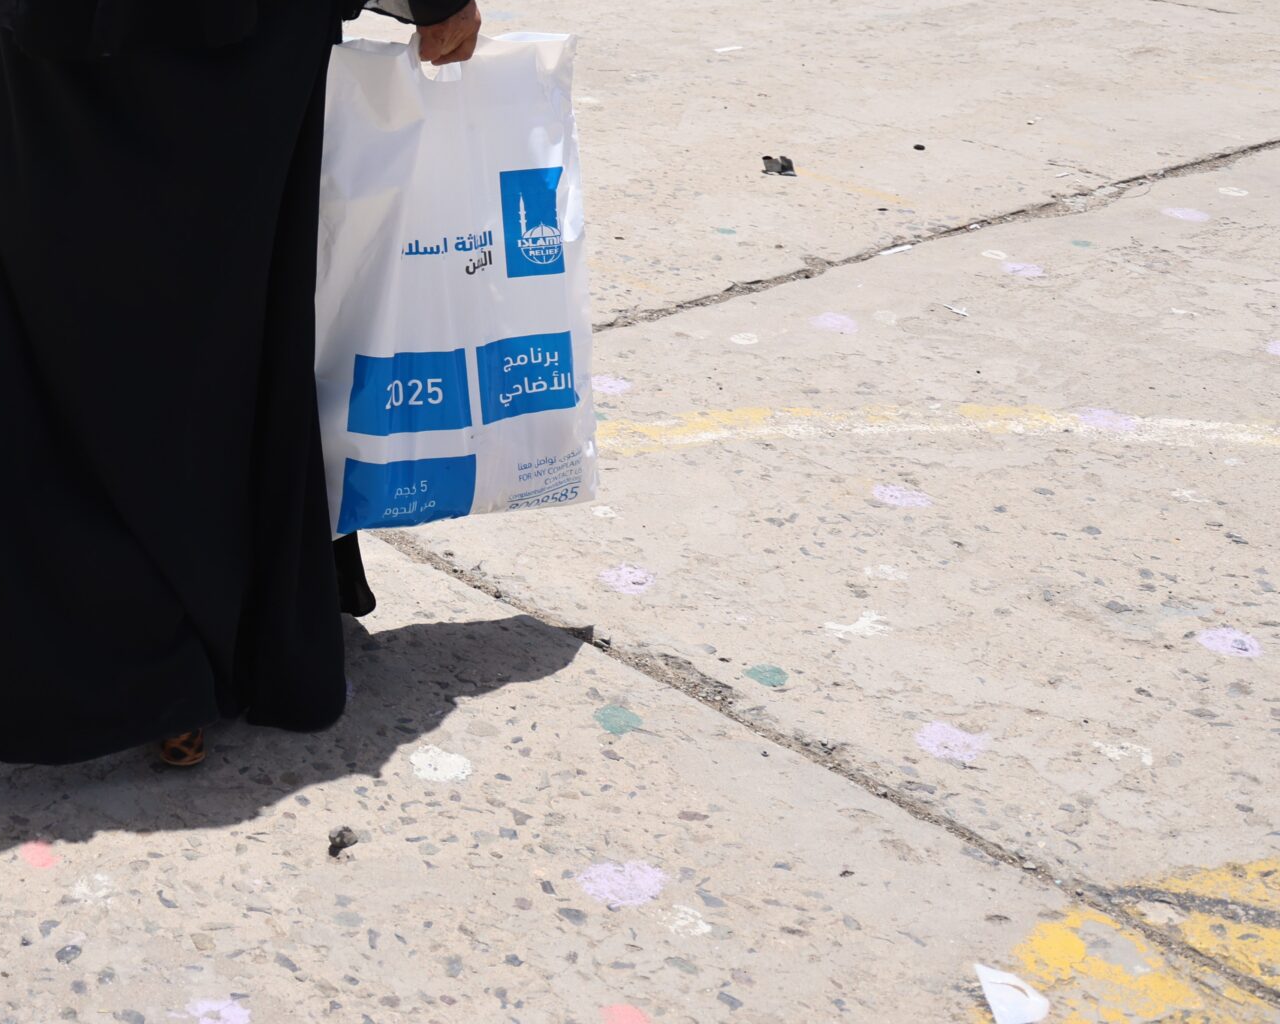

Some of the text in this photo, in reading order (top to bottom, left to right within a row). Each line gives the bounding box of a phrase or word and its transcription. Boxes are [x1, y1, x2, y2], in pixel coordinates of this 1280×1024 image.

[529, 248, 559, 257] RELIEF
[503, 346, 559, 373] برنامج
[384, 378, 444, 410] 2025
[499, 371, 572, 407] الأضاحي
[517, 462, 533, 471] معنا
[518, 473, 532, 482] FOR
[420, 480, 428, 492] 5
